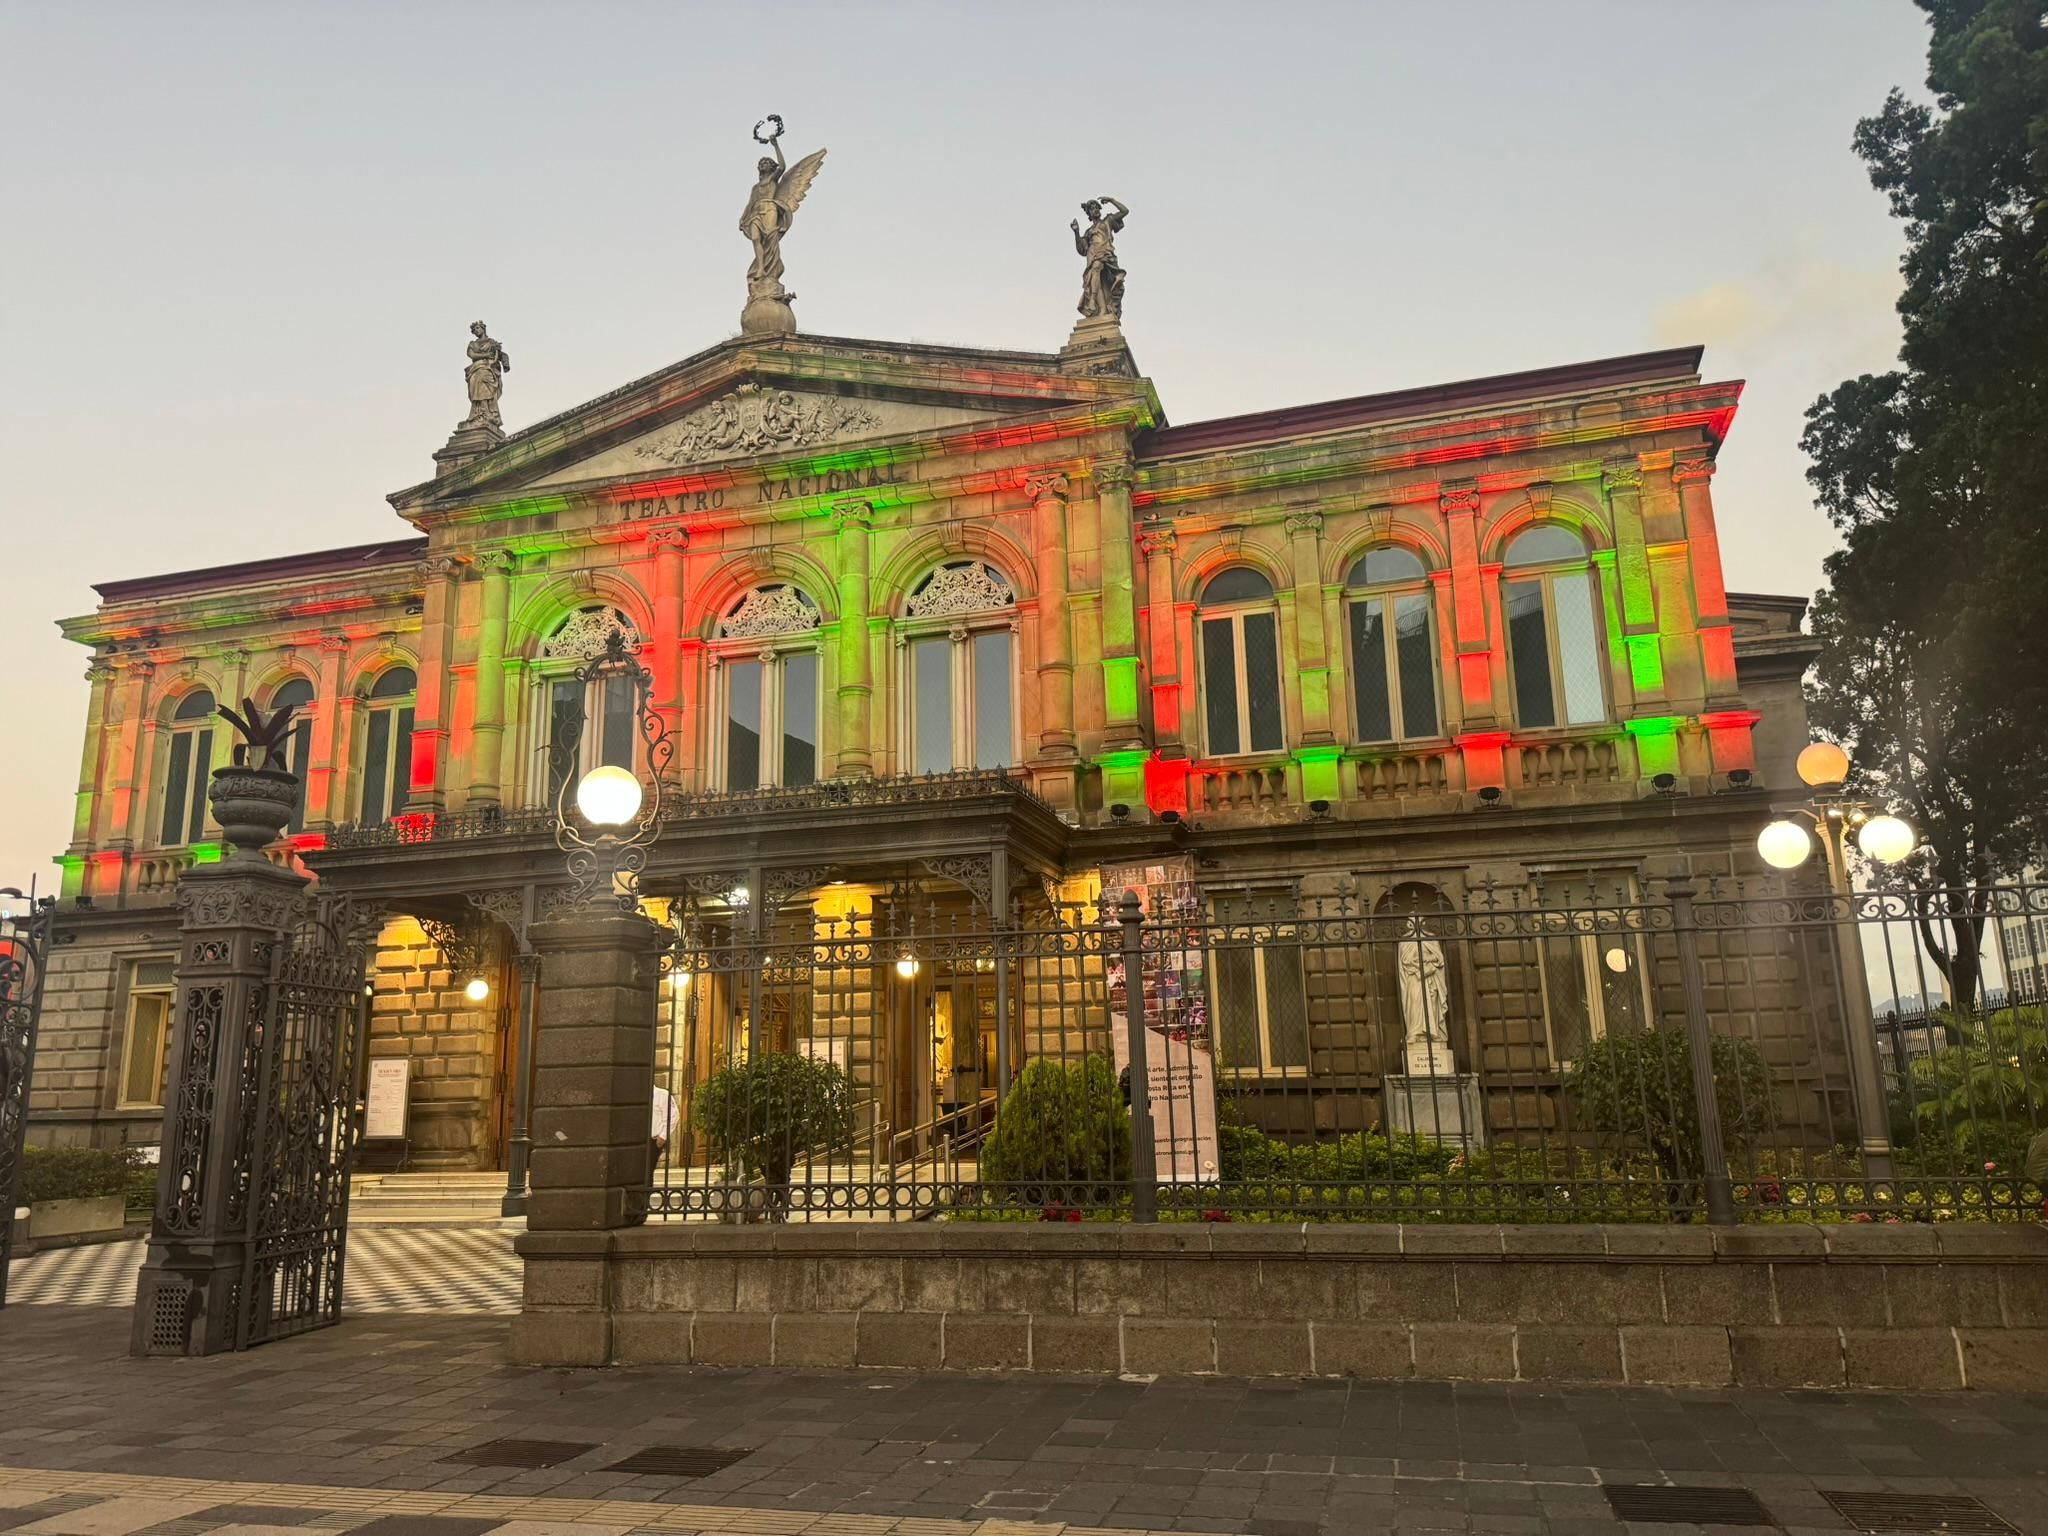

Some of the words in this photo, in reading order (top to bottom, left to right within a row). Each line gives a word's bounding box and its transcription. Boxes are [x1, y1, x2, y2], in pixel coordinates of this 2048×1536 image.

[620, 488, 725, 520] TEATRO
[758, 464, 907, 502] NACIONAL
[1178, 1073, 1202, 1081] orgllo
